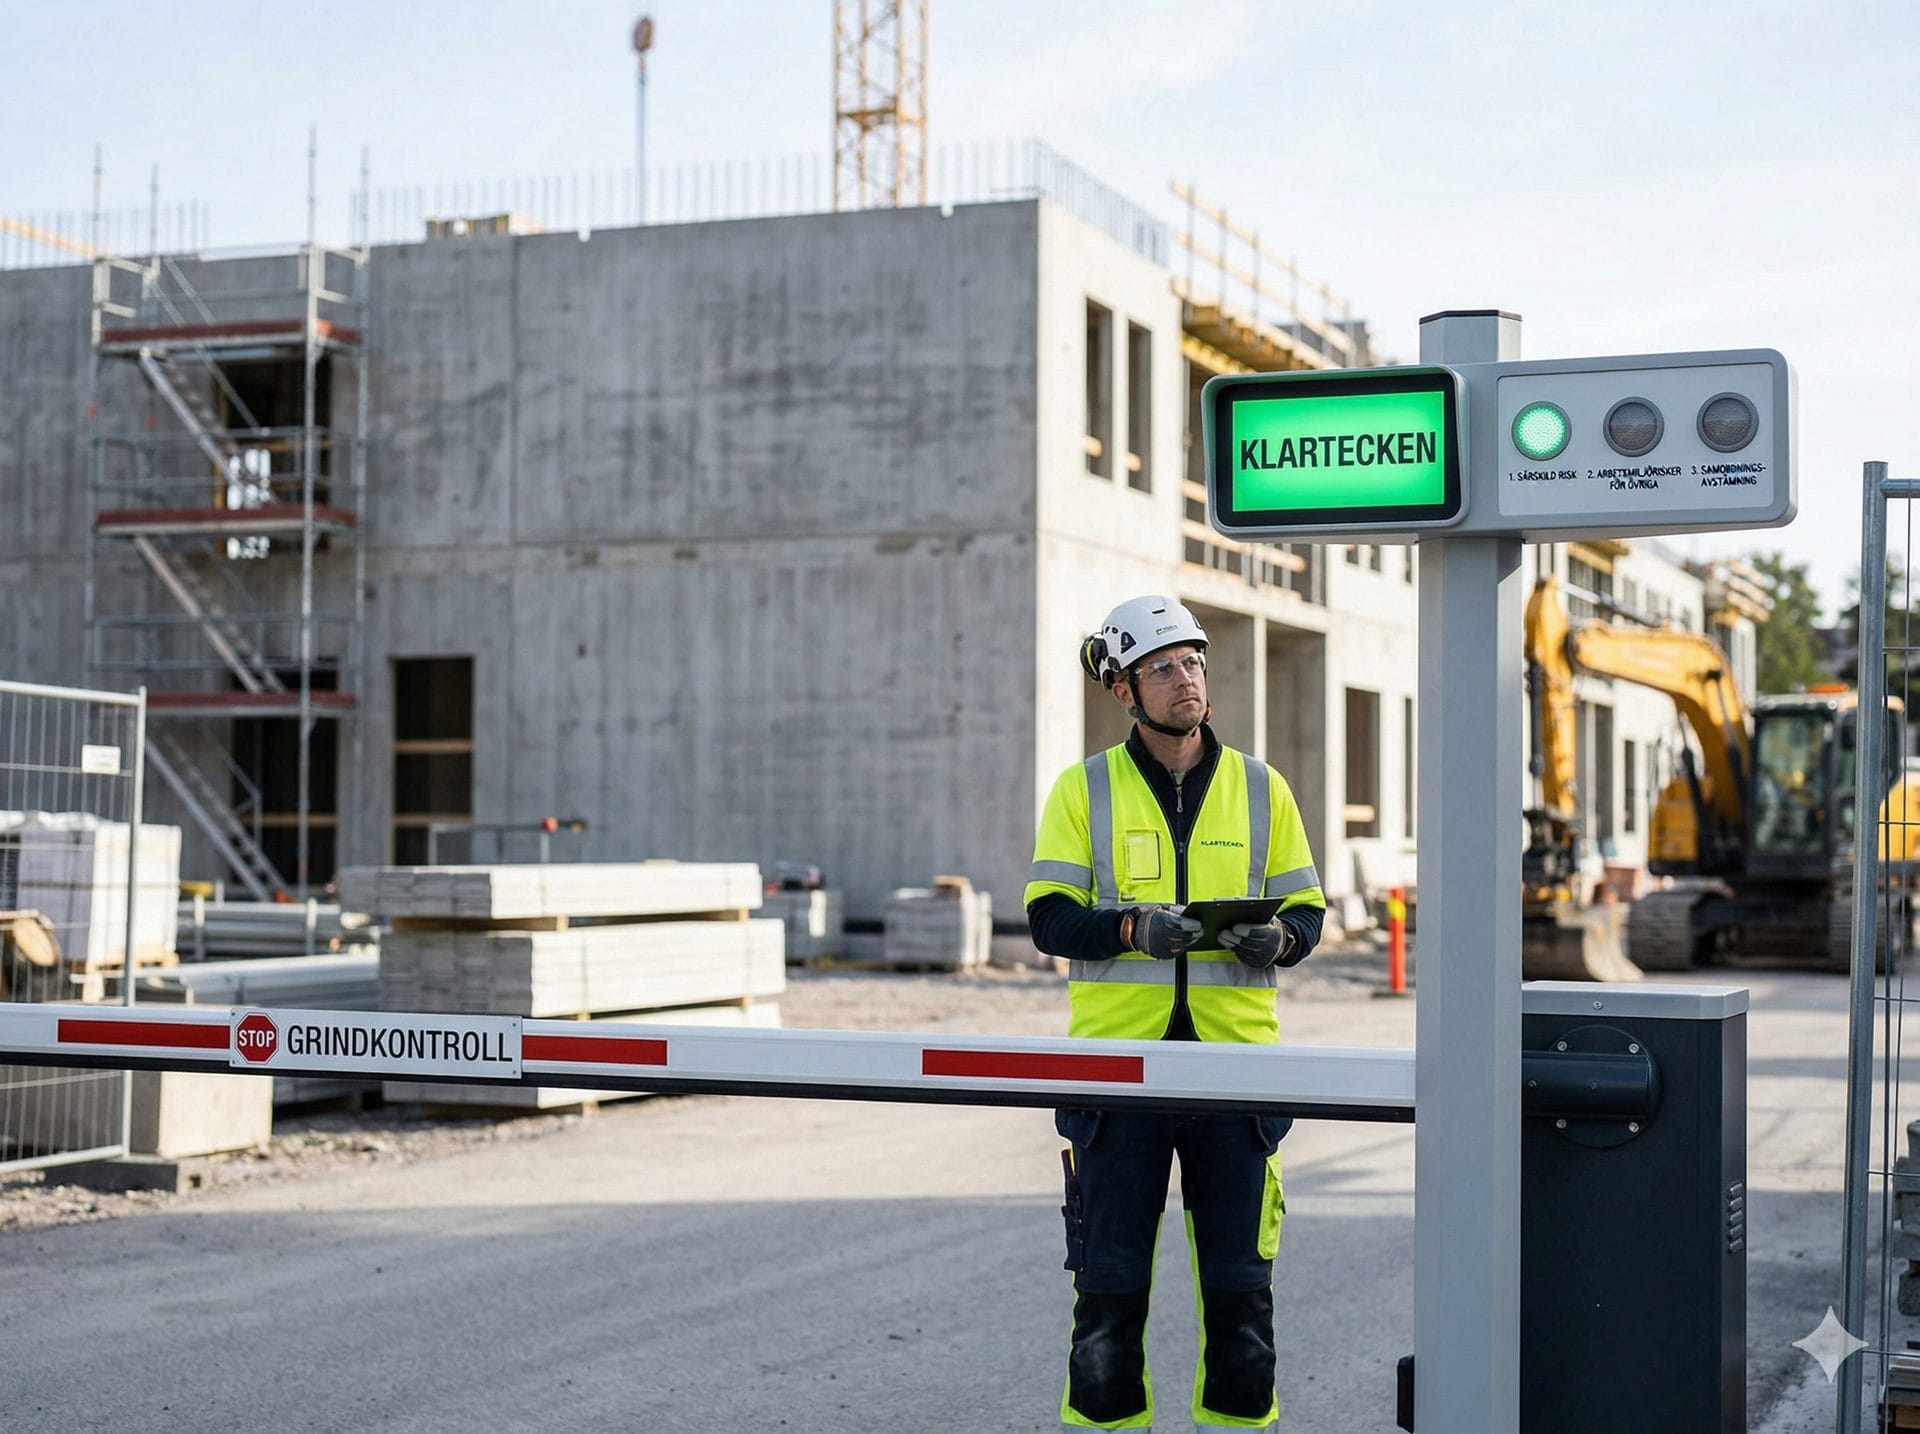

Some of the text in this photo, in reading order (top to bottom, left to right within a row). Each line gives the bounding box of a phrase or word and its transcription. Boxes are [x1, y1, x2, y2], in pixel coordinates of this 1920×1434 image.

[1240, 431, 1437, 470] KLARTECKEN
[1558, 470, 1577, 480] RISK
[1609, 478, 1626, 490] FÖR
[238, 1029, 276, 1048] STOP
[287, 1025, 513, 1062] GRINDKONTROLL
